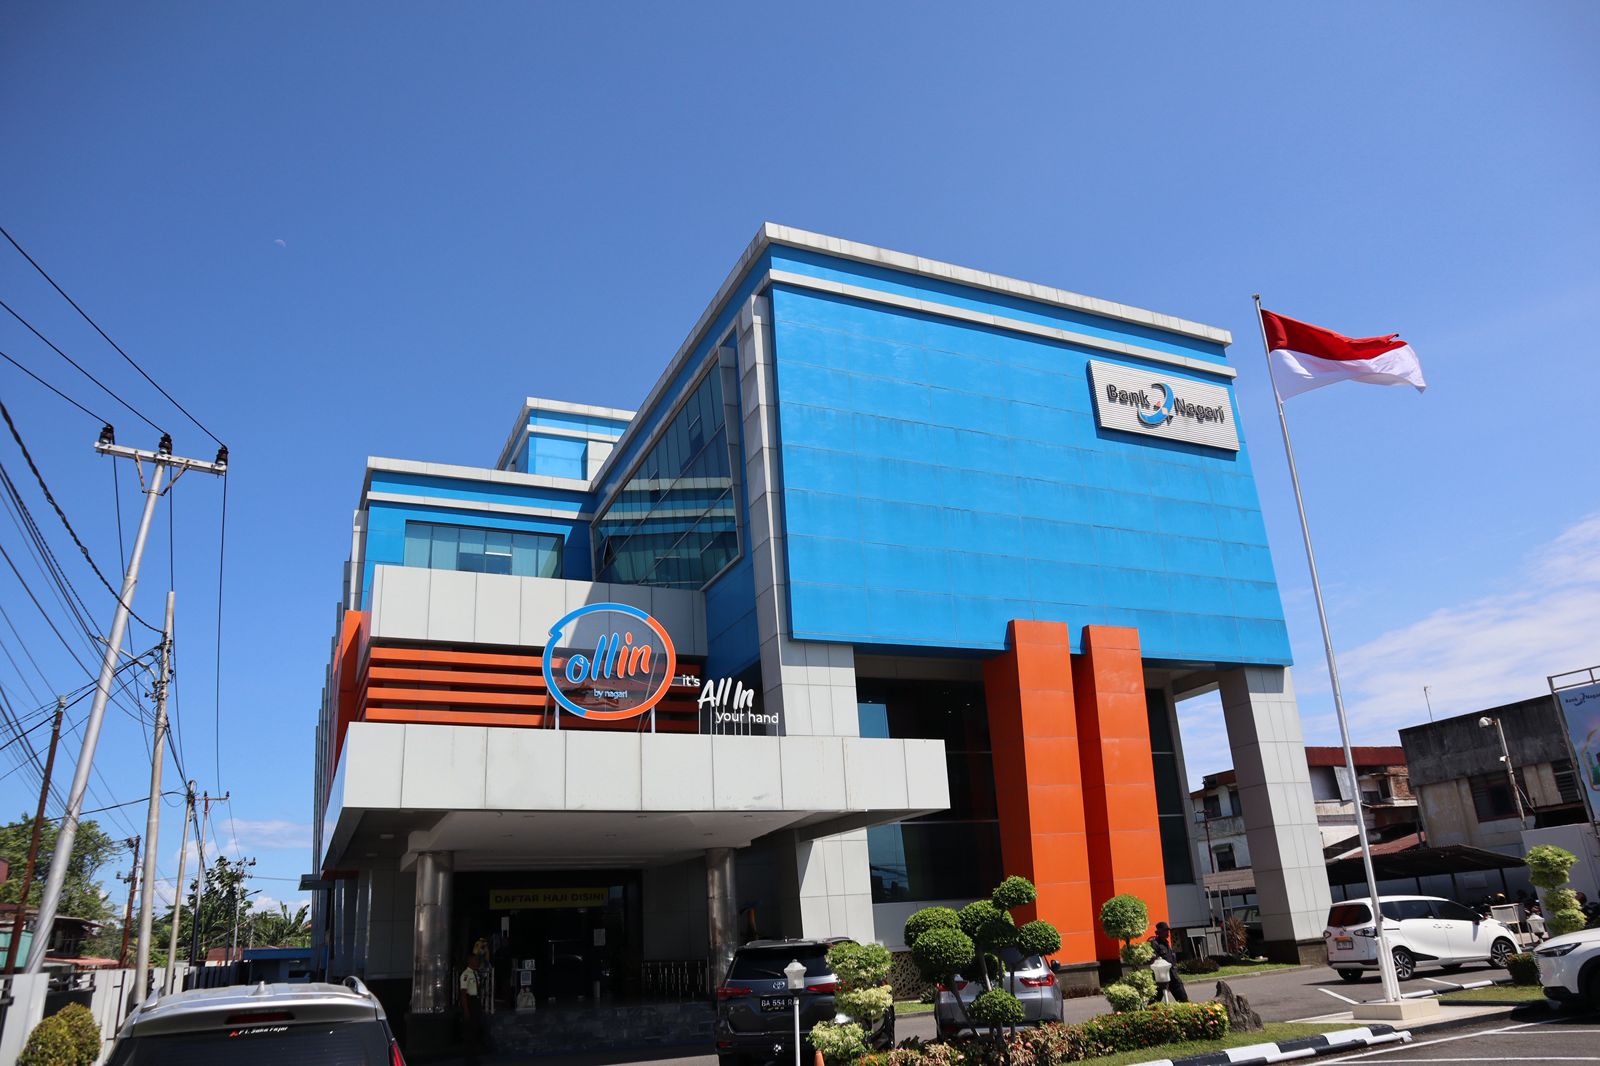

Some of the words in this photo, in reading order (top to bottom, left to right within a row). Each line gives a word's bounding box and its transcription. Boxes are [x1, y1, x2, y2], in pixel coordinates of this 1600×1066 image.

[1107, 384, 1151, 406] Bank
[1174, 398, 1225, 421] Nagari
[593, 689, 603, 698] by
[604, 690, 628, 699] nagari
[682, 674, 701, 687] it's
[697, 677, 732, 709] All
[733, 680, 755, 710] In
[715, 711, 744, 724] your
[748, 711, 779, 724] hand
[495, 895, 539, 904] DAFTAR
[543, 893, 567, 902] HAJI
[571, 892, 604, 902] DISINI
[761, 999, 770, 1007] BA
